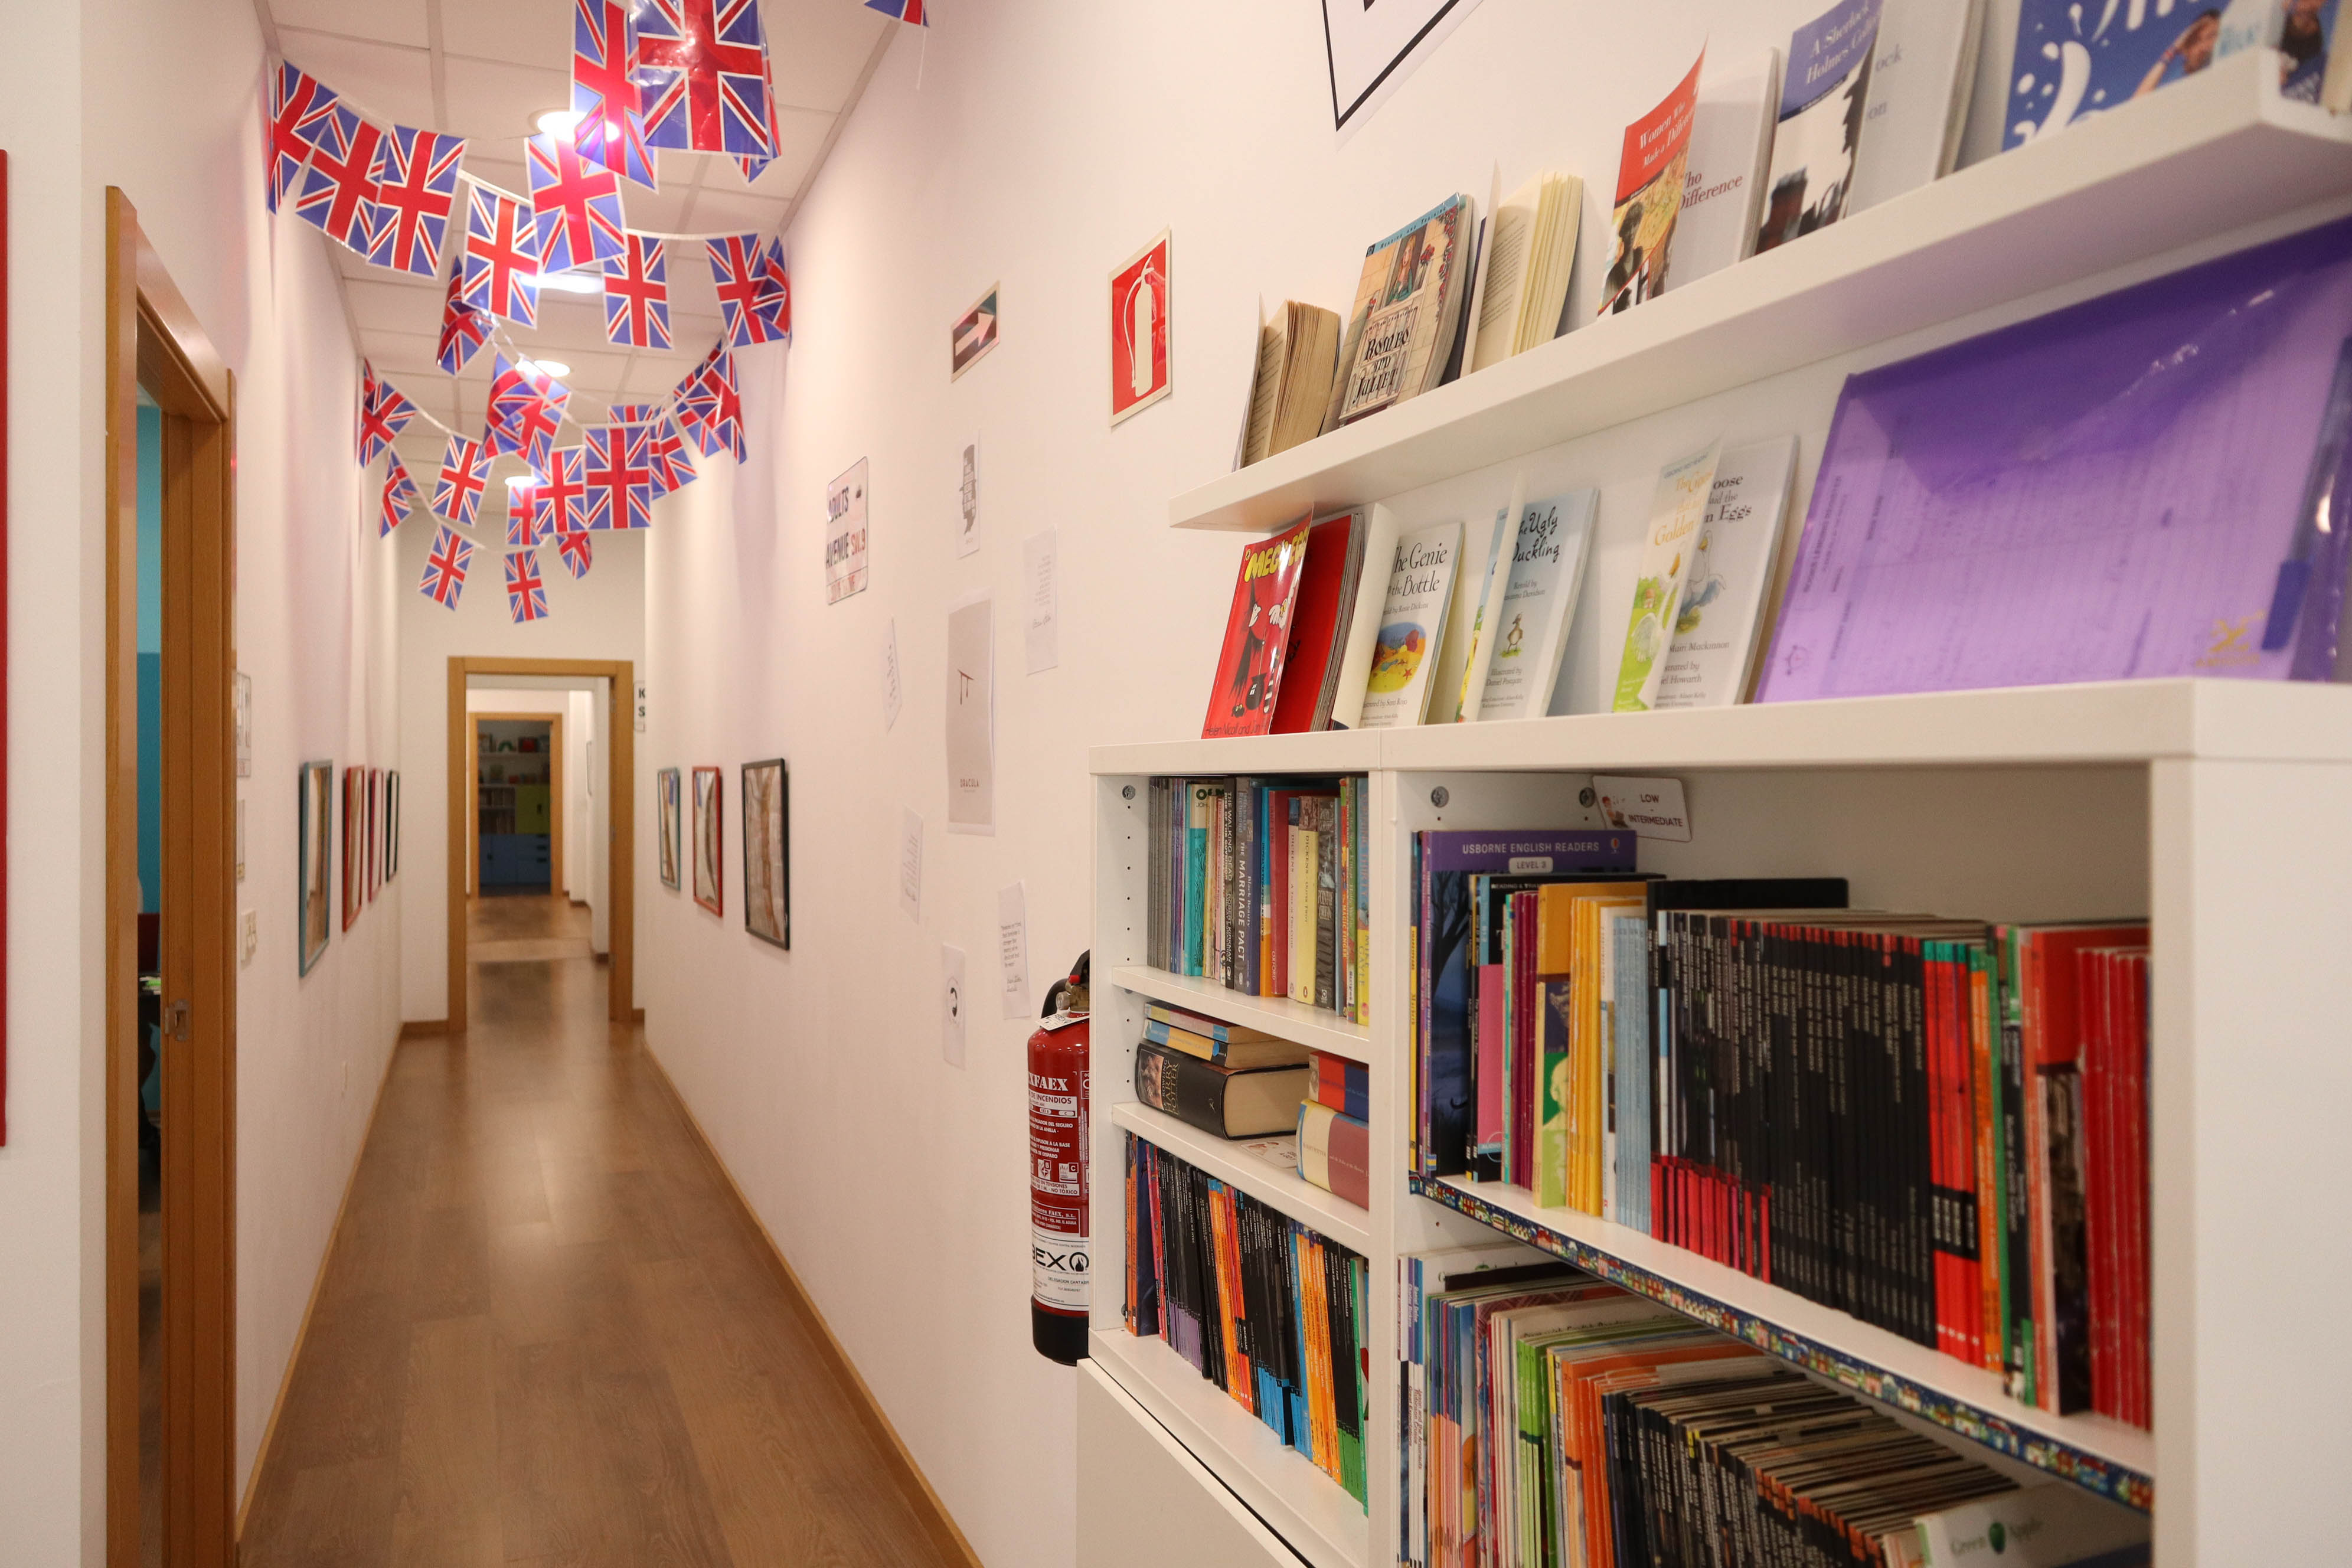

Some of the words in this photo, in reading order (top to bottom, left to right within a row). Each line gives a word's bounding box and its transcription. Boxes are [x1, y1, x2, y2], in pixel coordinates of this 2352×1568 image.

[1639, 115, 1672, 150] Women
[1642, 146, 1660, 169] Made
[1684, 171, 1703, 188] ho
[1713, 475, 1744, 490] oose
[1518, 517, 1527, 535] he
[1528, 506, 1559, 535] Ugly
[826, 533, 850, 569] AVENUE
[1409, 541, 1448, 570] Genie
[1402, 569, 1440, 597] Bottle
[1640, 794, 1660, 803] LOW
[1628, 814, 1684, 828] INTERMEDIATE
[1462, 843, 1507, 855] USBORNE
[1510, 842, 1551, 853] ENGLISH
[1555, 842, 1600, 852] READERS
[1516, 861, 1539, 870] LEVEL
[1036, 1094, 1072, 1105] INCENDIOS
[1045, 1180, 1068, 1188] TENSIONES
